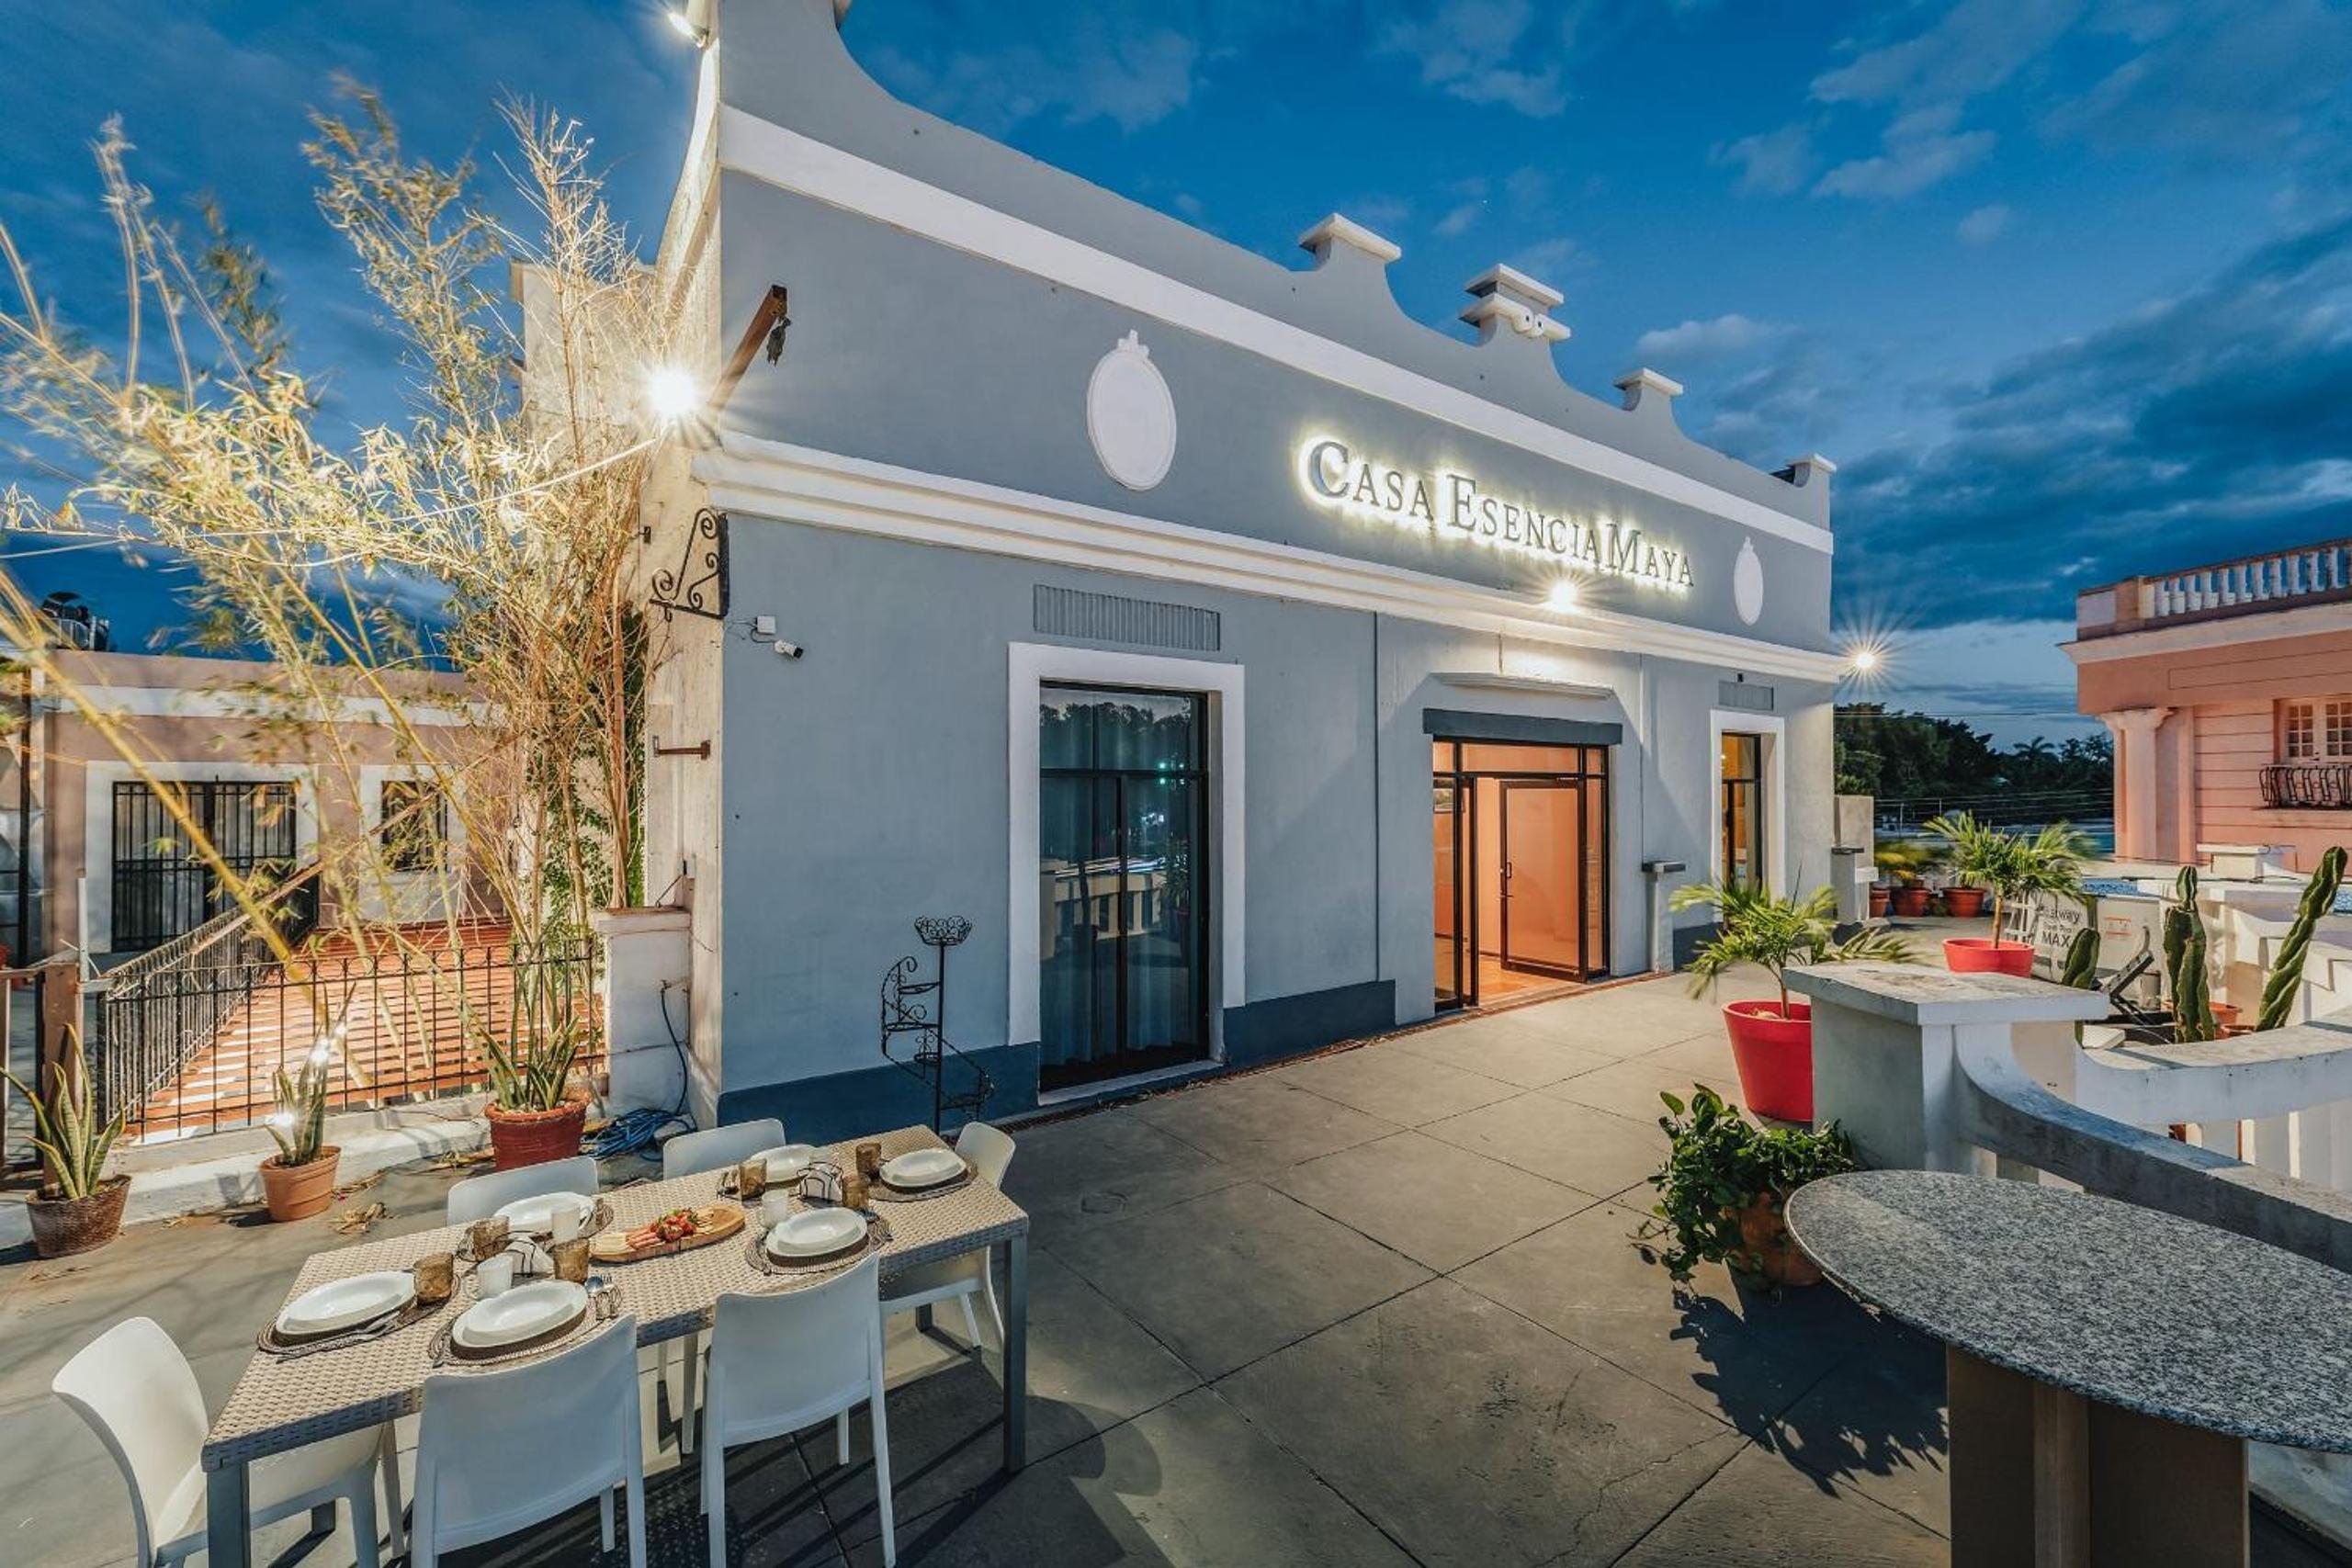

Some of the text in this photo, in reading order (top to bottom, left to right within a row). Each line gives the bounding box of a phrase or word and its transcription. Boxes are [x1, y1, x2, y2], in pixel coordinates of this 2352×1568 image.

[1308, 442, 1694, 587] CASA ESENCIA MAYA
[2042, 931, 2070, 947] MAX
